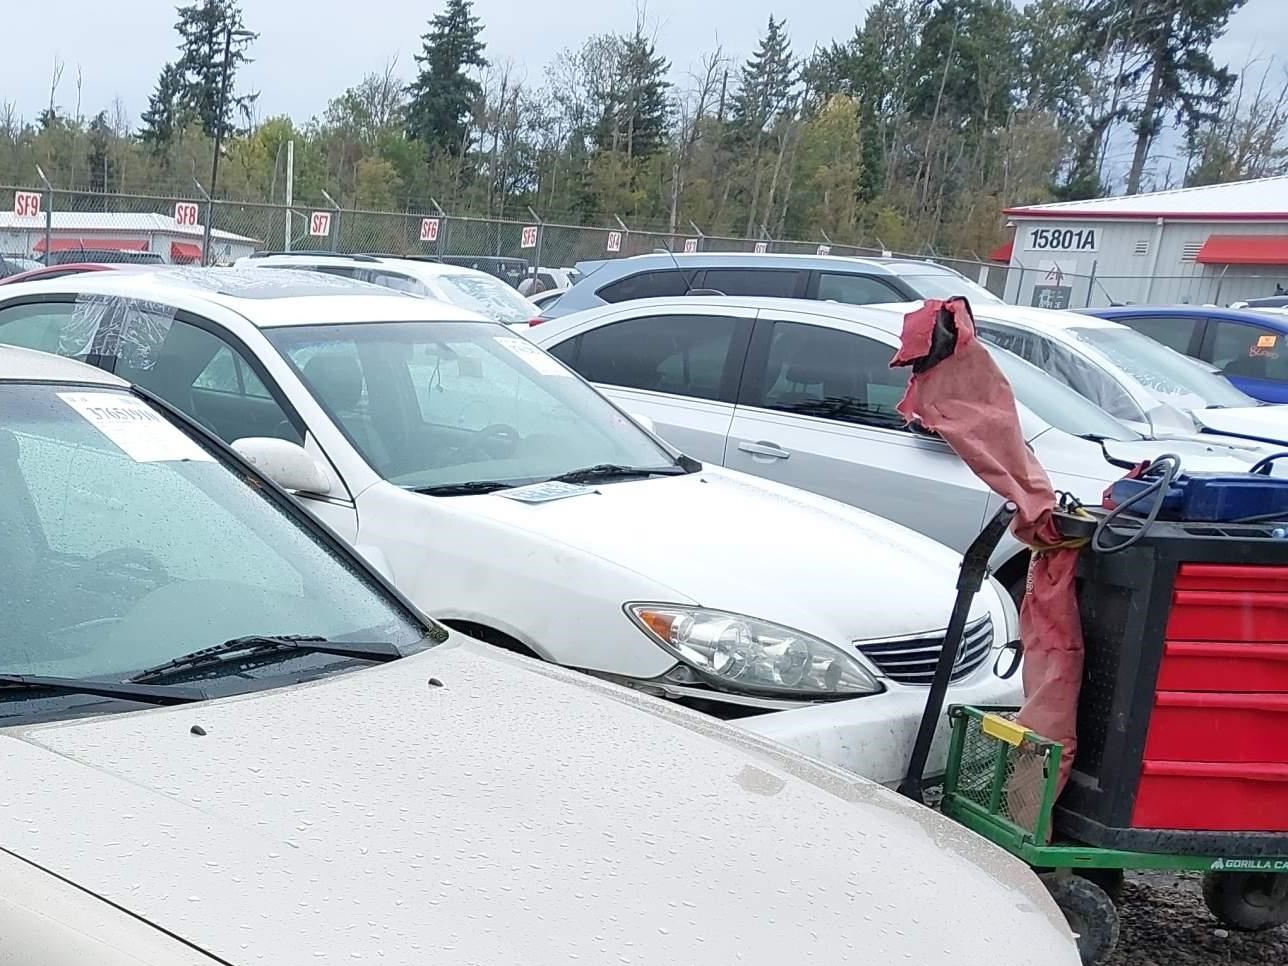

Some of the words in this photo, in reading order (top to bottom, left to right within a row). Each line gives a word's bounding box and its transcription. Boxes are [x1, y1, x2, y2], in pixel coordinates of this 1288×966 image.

[17, 194, 38, 216] SF9
[176, 205, 196, 226] SF8
[312, 214, 329, 233] SF7
[422, 221, 437, 238] SF6
[523, 228, 536, 246] SF5
[1030, 228, 1095, 249] 15801A
[608, 232, 620, 249] SF4
[1225, 859, 1272, 869] GORILLA
